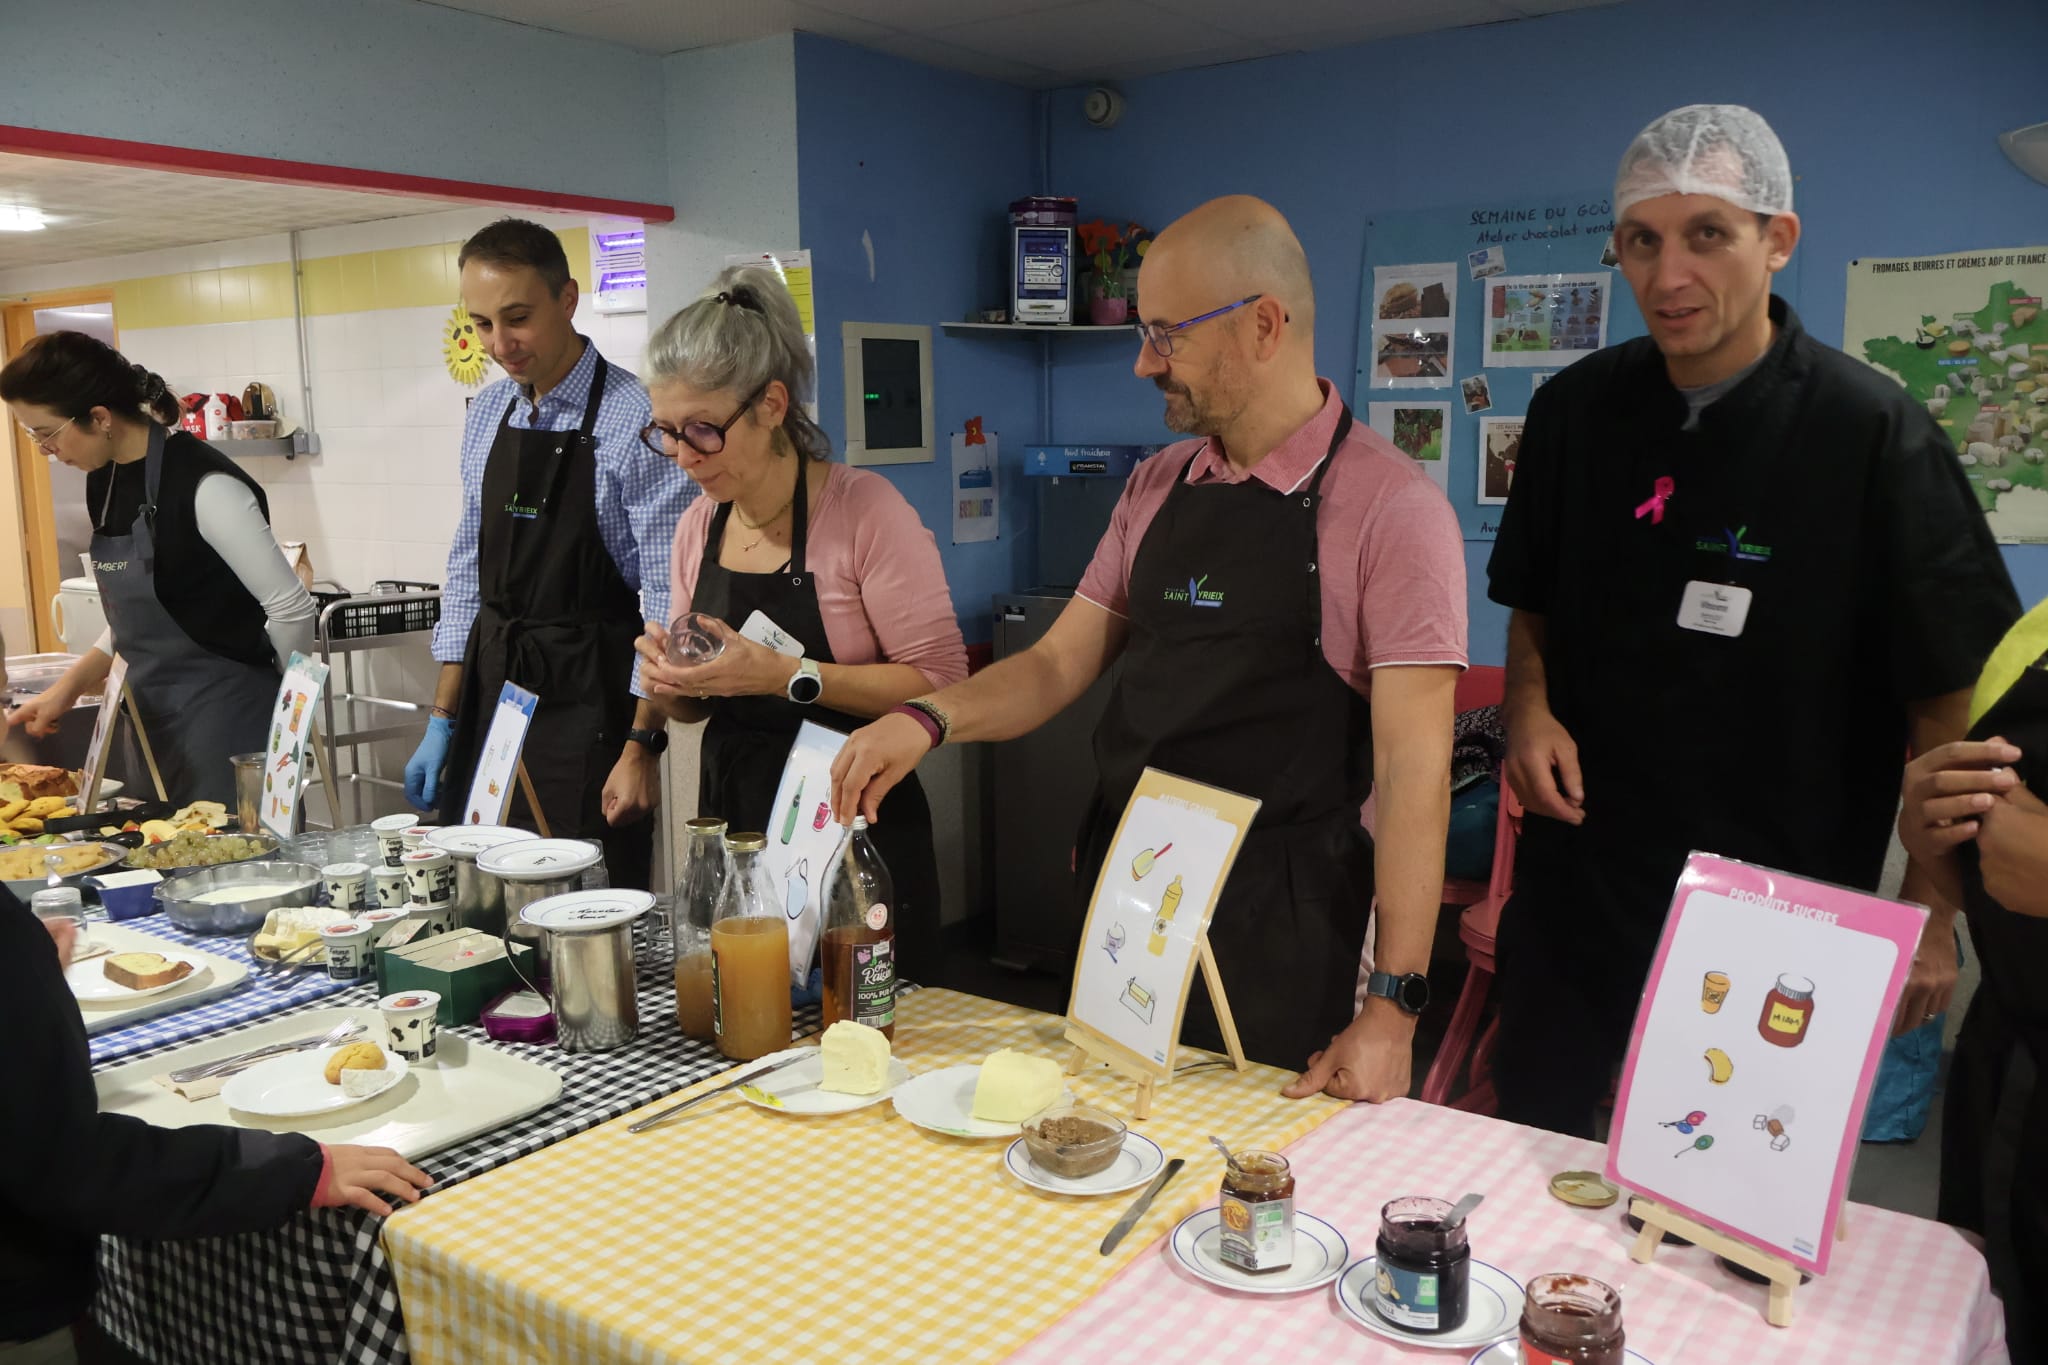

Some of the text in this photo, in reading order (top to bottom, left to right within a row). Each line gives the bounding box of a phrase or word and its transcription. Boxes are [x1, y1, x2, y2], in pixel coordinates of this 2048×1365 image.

[1470, 200, 1612, 225] SEMAINE DU GOÛ
[1476, 220, 1616, 244] Atelier chocolat vend
[1912, 260, 1945, 272] BEURRES
[1946, 259, 1956, 270] ET
[1988, 255, 2004, 267] AOP
[2005, 255, 2014, 266] DE
[2017, 253, 2047, 265] FRANCE
[1163, 590, 1224, 601] SAINT YRIEIX
[1729, 887, 1791, 914] PRODUITS
[858, 991, 878, 1000] 100%
